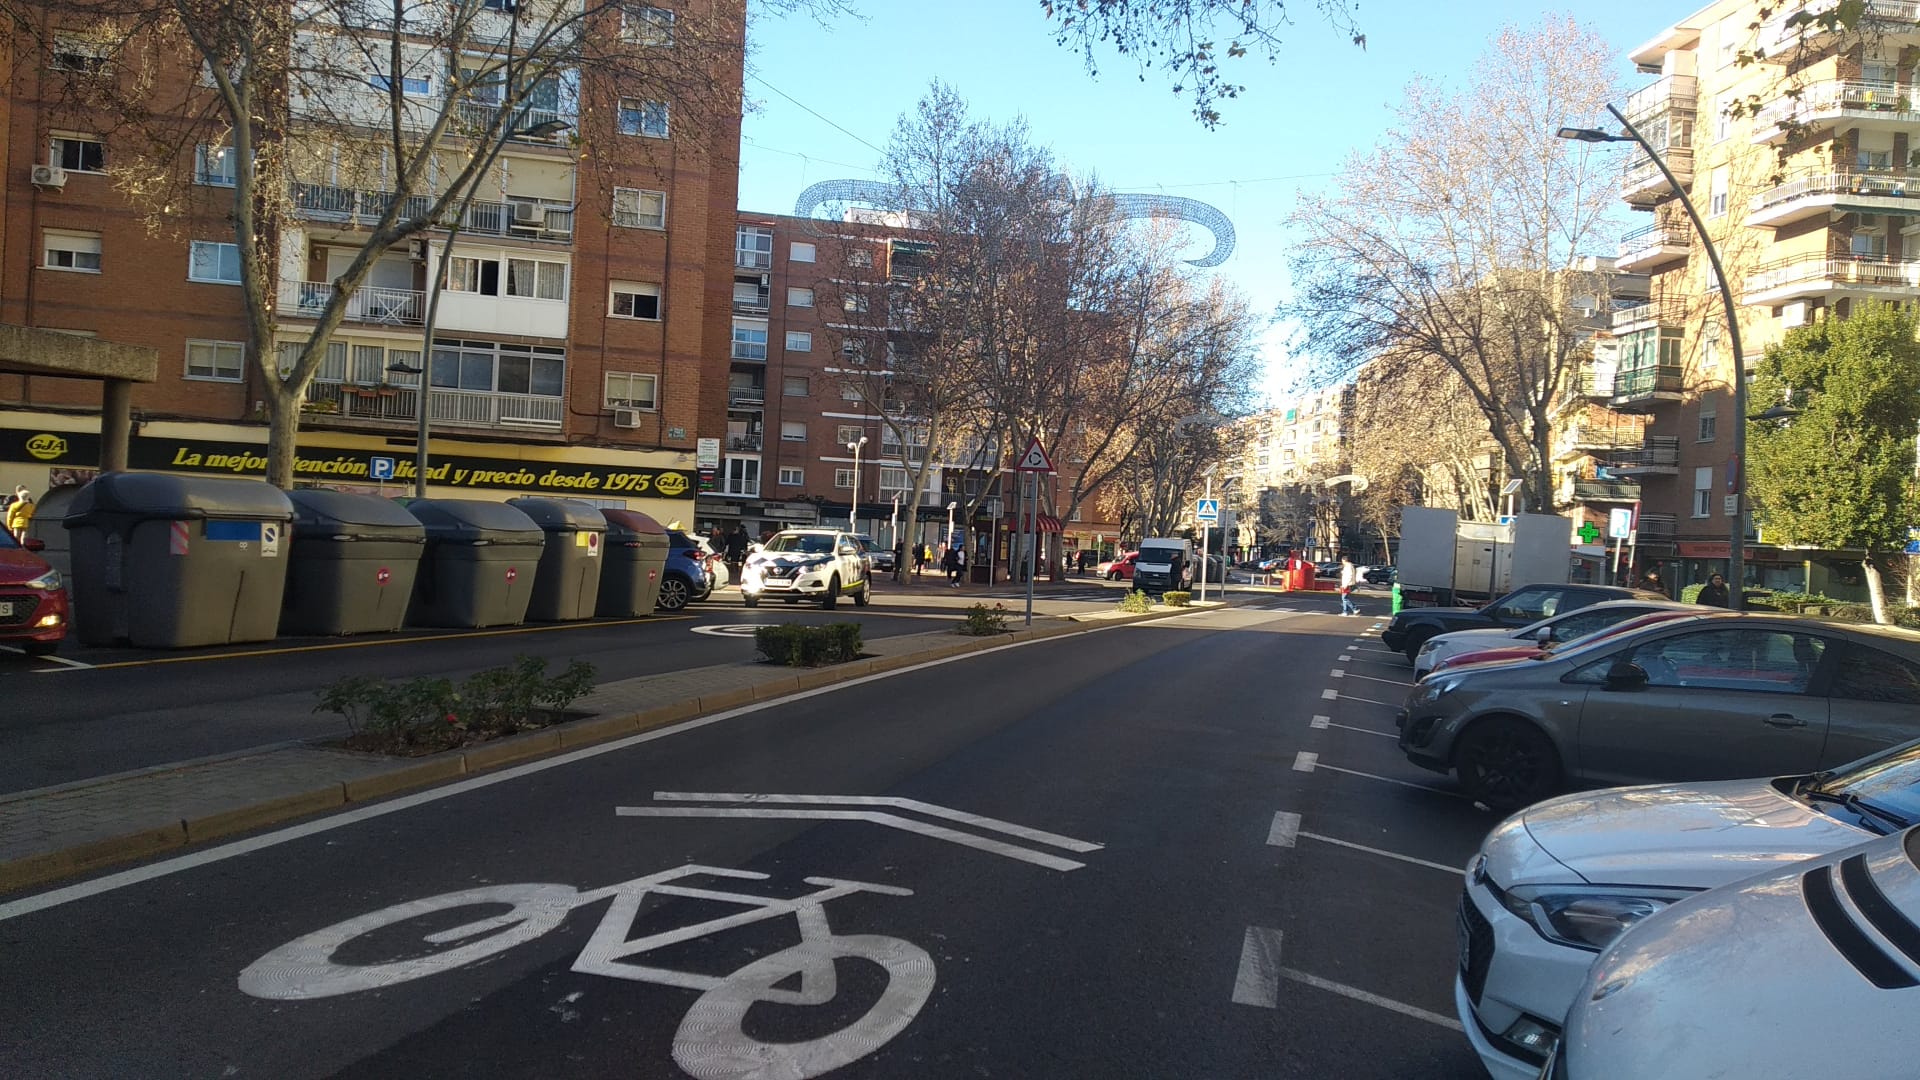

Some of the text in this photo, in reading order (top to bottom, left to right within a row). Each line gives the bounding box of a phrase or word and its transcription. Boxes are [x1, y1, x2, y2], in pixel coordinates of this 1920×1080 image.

[28, 439, 66, 451] GJA
[172, 447, 652, 492] La mejor tención, liad y precio desde 1975
[375, 459, 389, 476] P
[656, 477, 688, 488] GJA
